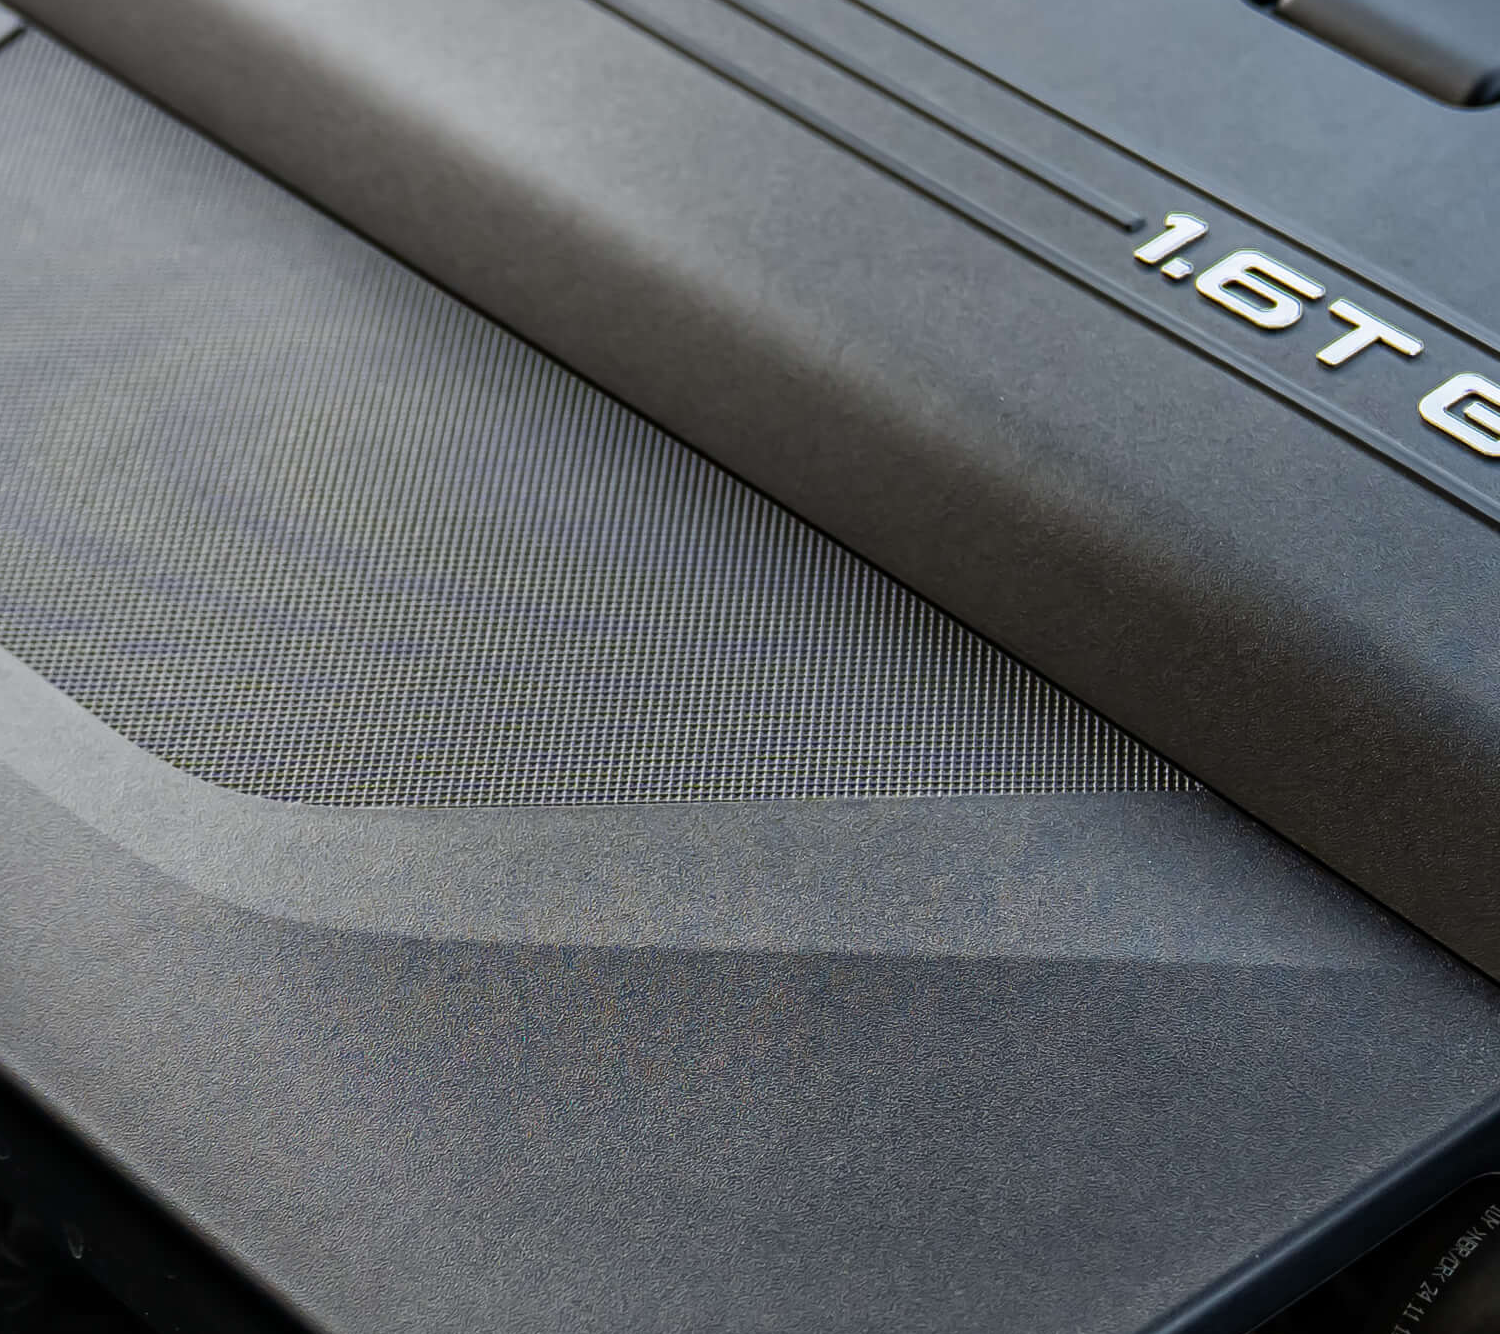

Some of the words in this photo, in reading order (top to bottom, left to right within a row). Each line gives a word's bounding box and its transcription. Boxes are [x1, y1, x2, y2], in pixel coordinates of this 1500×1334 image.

[1133, 211, 1424, 366] 1.6T
[1416, 1281, 1439, 1304] 24
[1403, 1301, 1426, 1322] 11
